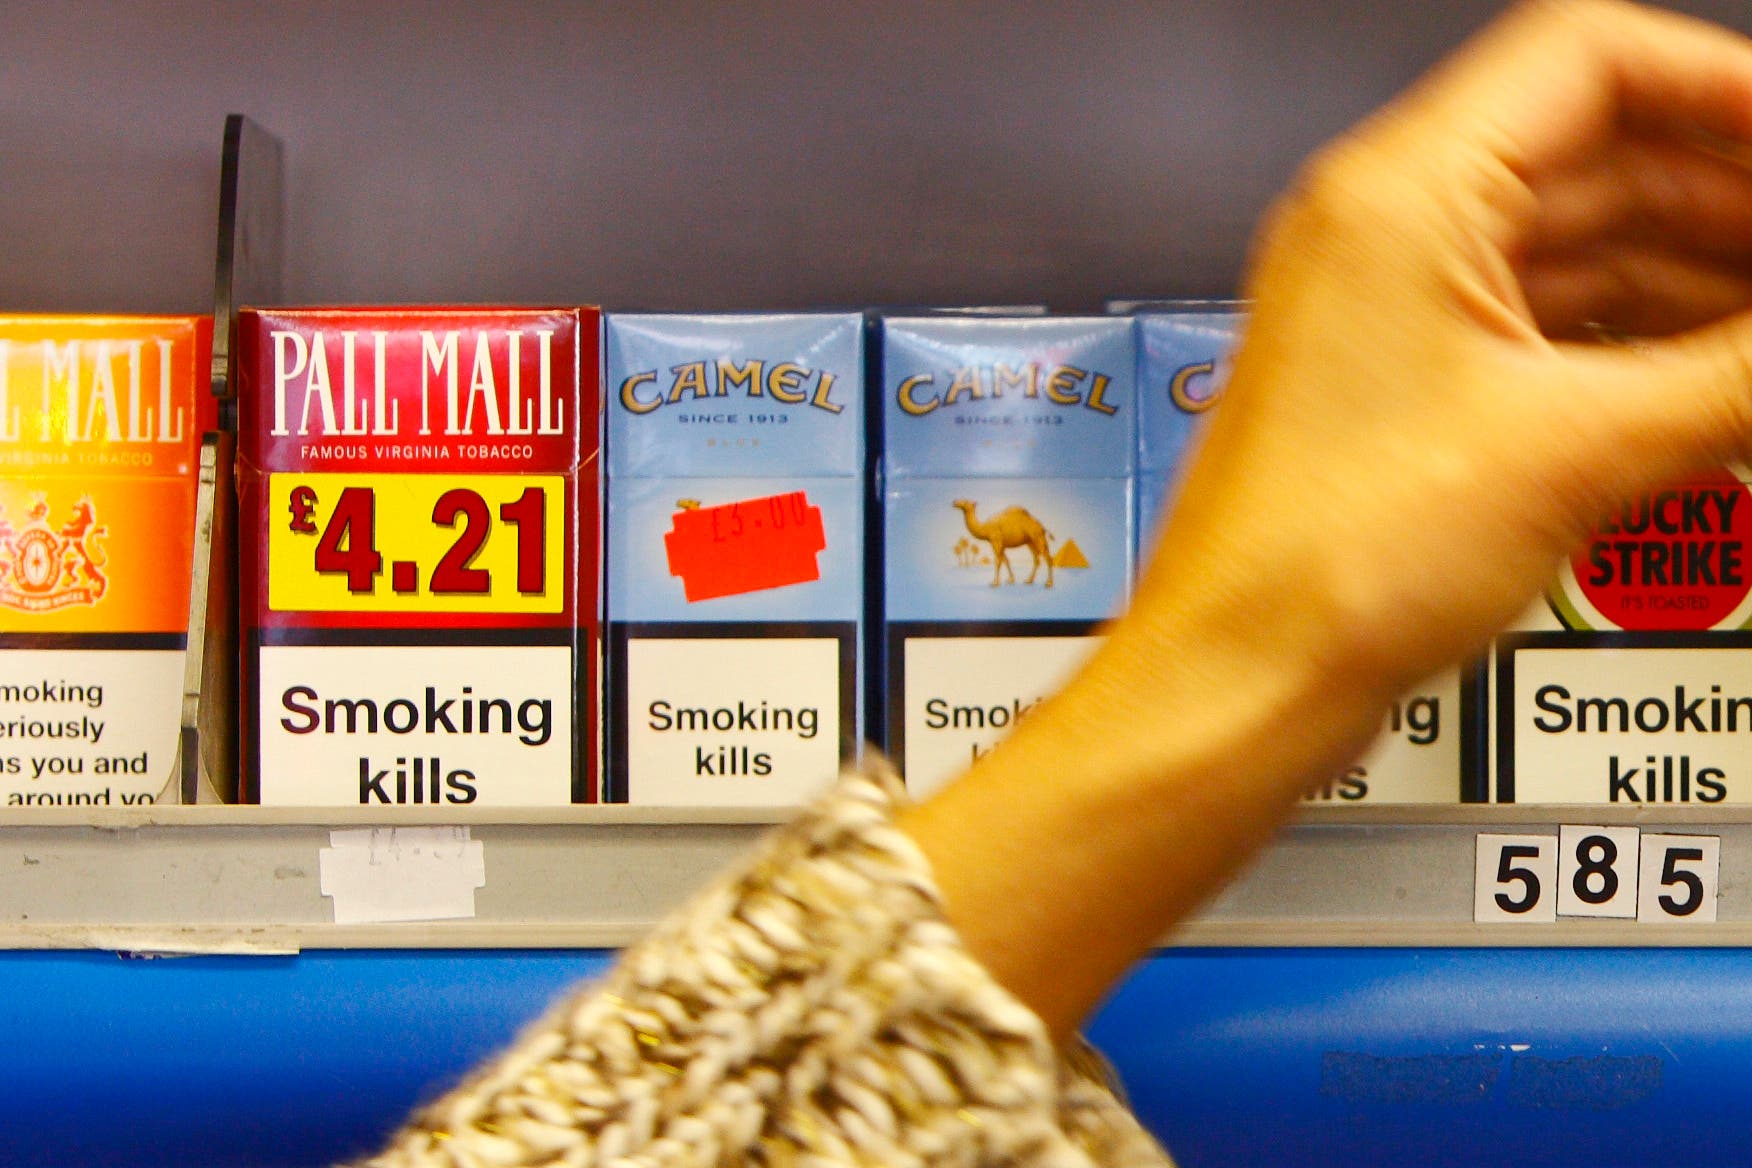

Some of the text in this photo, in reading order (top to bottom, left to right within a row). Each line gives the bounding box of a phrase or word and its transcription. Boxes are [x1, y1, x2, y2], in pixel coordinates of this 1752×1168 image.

[40, 340, 183, 442] MALL
[271, 331, 563, 435] PALL MALL
[619, 359, 846, 415] CAMEL
[897, 362, 1119, 416] CAMEL
[678, 414, 788, 424] SINCE 1913
[301, 444, 533, 459] FAMOUS VIRGINIA TOBACCO
[288, 485, 547, 597] £4.21
[1589, 541, 1743, 587] STRIKE
[280, 685, 553, 746] Smoking
[648, 700, 818, 738] Smoking
[32, 756, 83, 779] you
[94, 752, 147, 774] and
[358, 757, 478, 804] kills
[695, 747, 772, 776] kills
[1608, 755, 1728, 803] kills
[1493, 834, 1704, 917] 585
